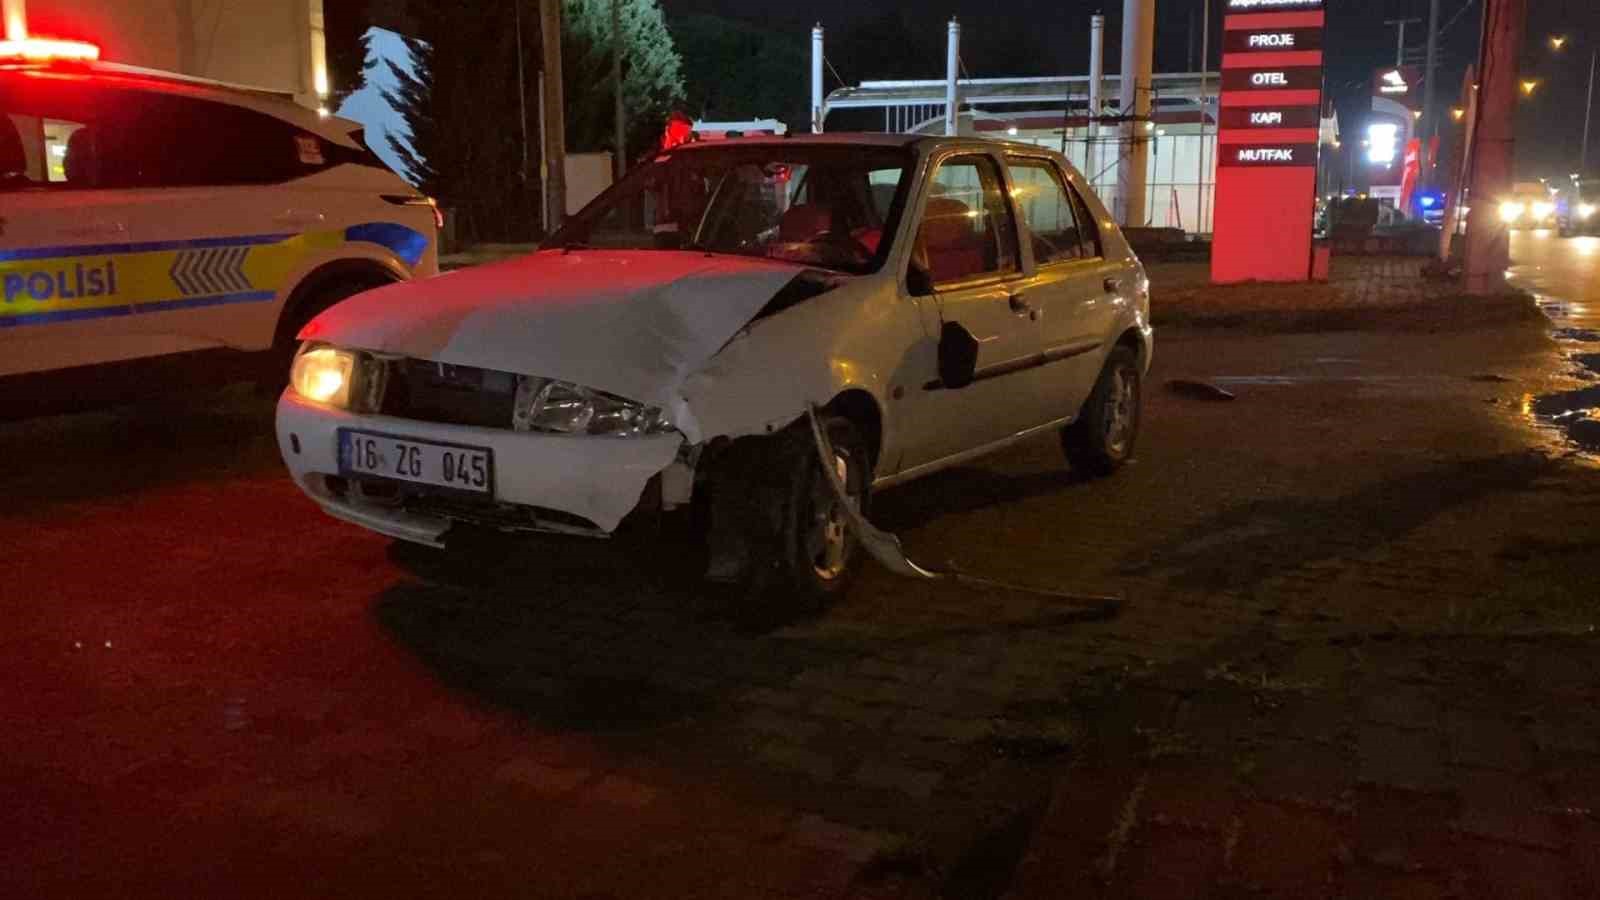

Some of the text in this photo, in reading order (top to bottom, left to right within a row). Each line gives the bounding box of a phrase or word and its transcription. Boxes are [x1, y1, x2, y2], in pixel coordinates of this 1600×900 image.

[1250, 34, 1294, 46] PROJE
[1252, 73, 1288, 84] OTEL
[1251, 112, 1282, 124] KAPI
[1238, 149, 1293, 161] MUTFAK
[3, 261, 118, 302] POLİSİ
[353, 437, 486, 487] 16 ZG 045
